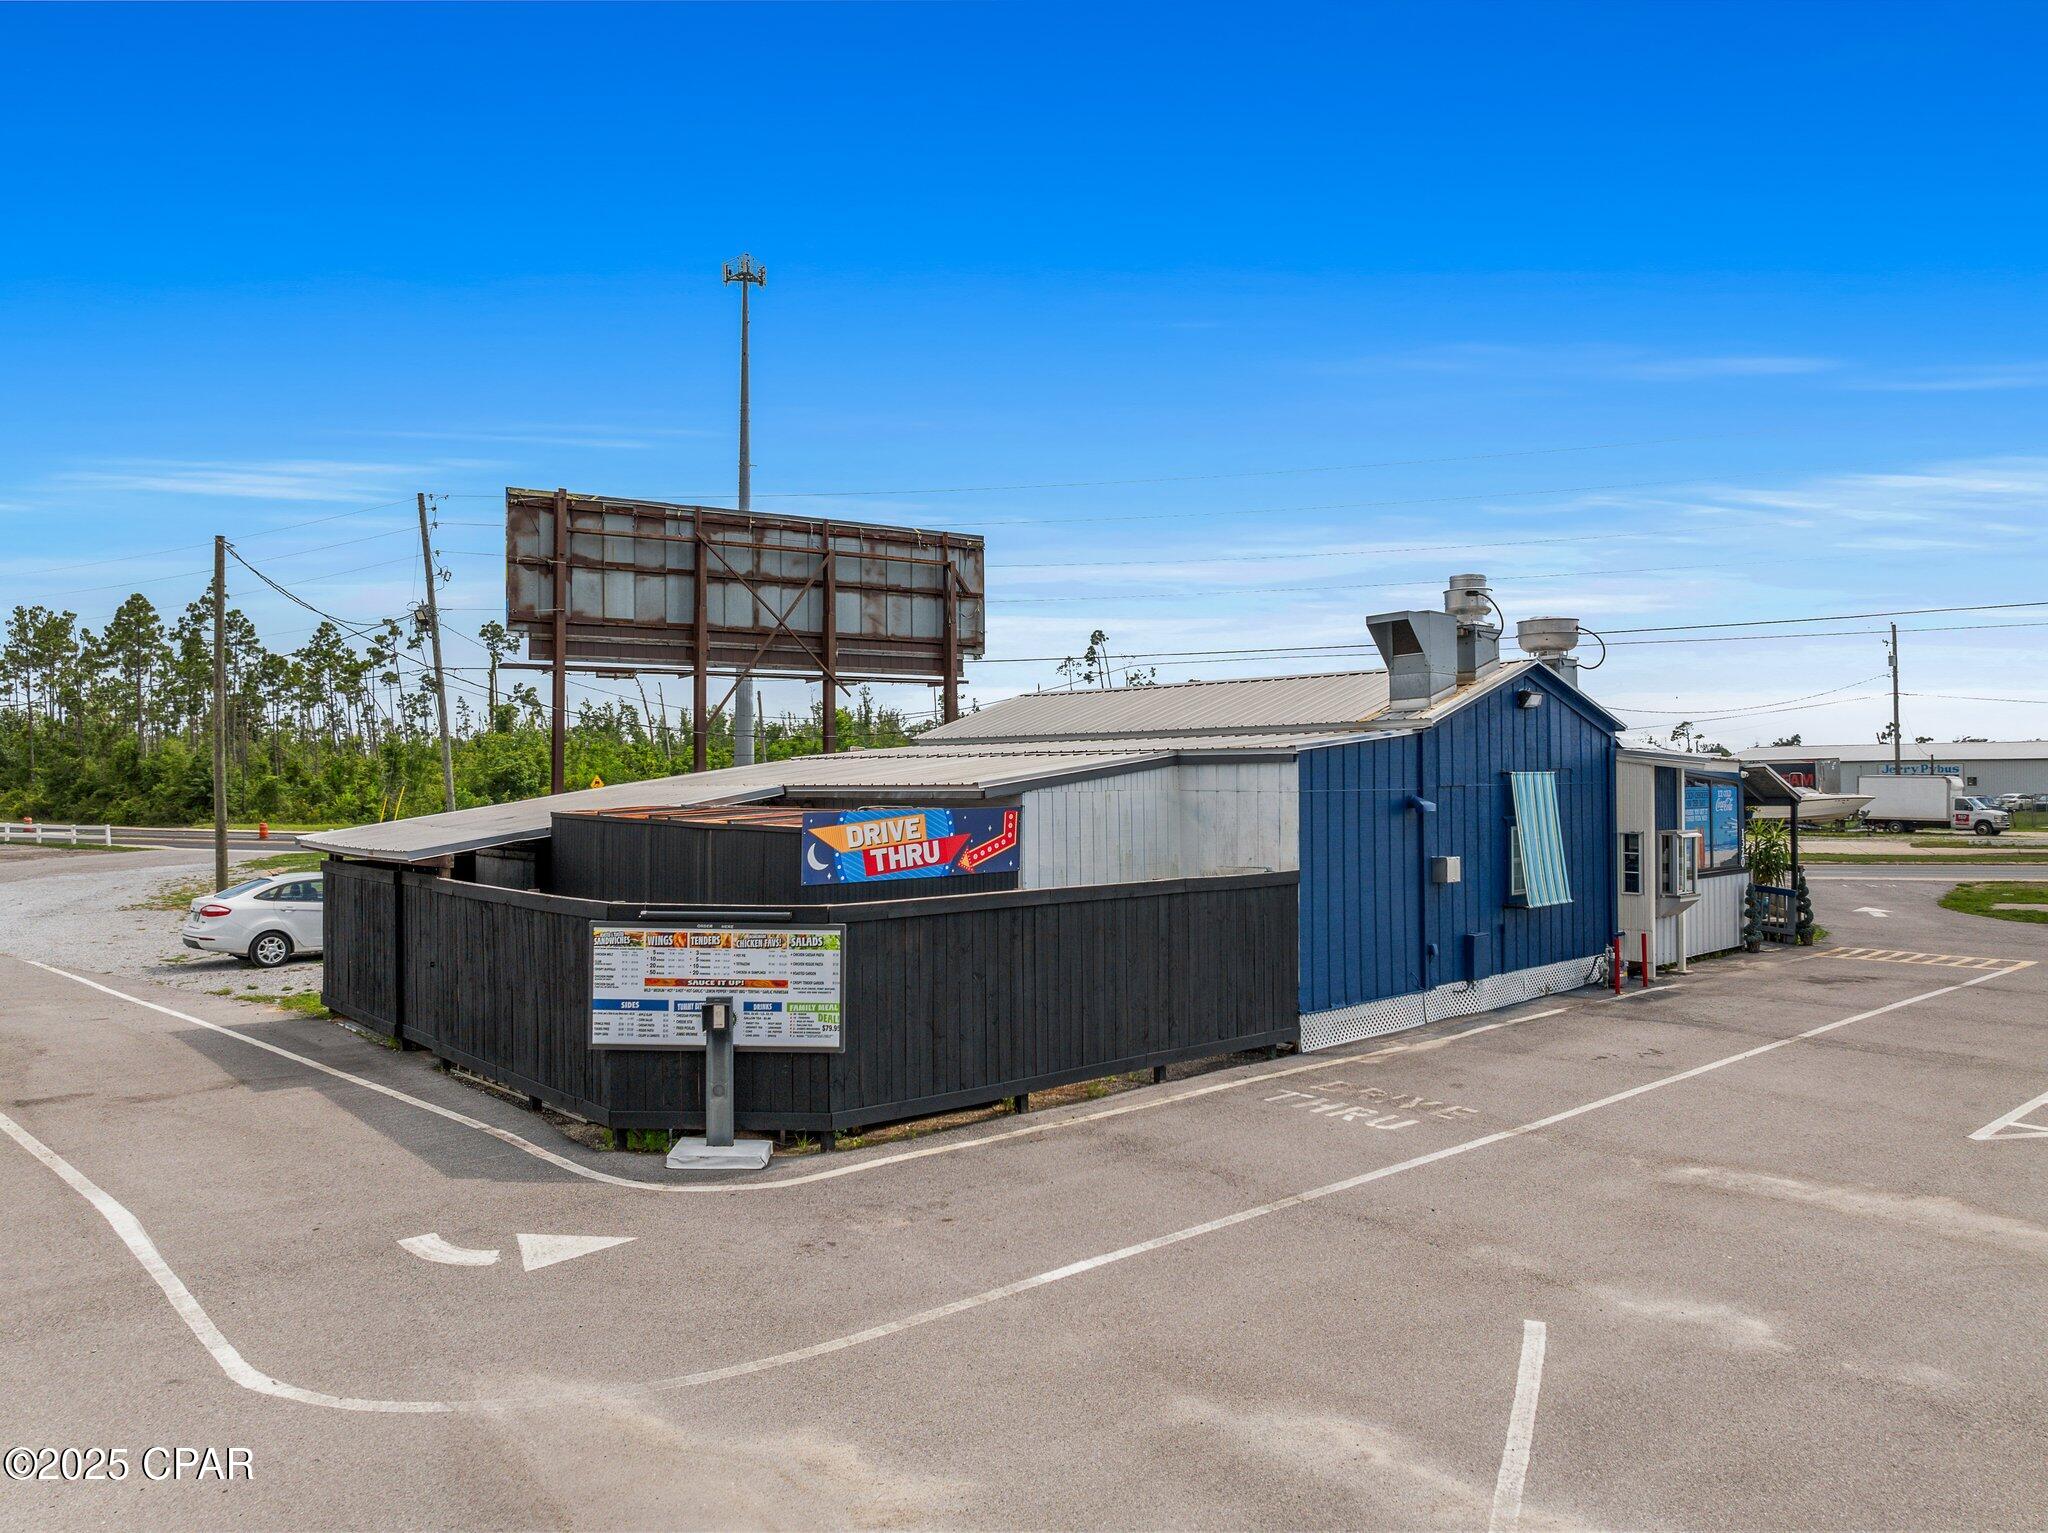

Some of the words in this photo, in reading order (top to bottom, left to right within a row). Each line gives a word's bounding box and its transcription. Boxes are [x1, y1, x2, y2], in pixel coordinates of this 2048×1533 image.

[846, 817, 921, 848] DRIVE
[869, 841, 941, 872] THRU
[593, 936, 631, 946] SANDWICHES
[647, 935, 673, 946] WINGS
[691, 935, 721, 946] TENDERS
[736, 938, 764, 948] CHICKEN
[764, 938, 782, 948] FAVS!
[790, 937, 823, 947] SALADS
[621, 1001, 640, 1009] SIDES
[753, 1003, 773, 1011] DRINKS
[789, 1003, 816, 1012] FAMILY
[817, 1003, 839, 1011] MEAL
[1263, 1089, 1420, 1130] THRU
